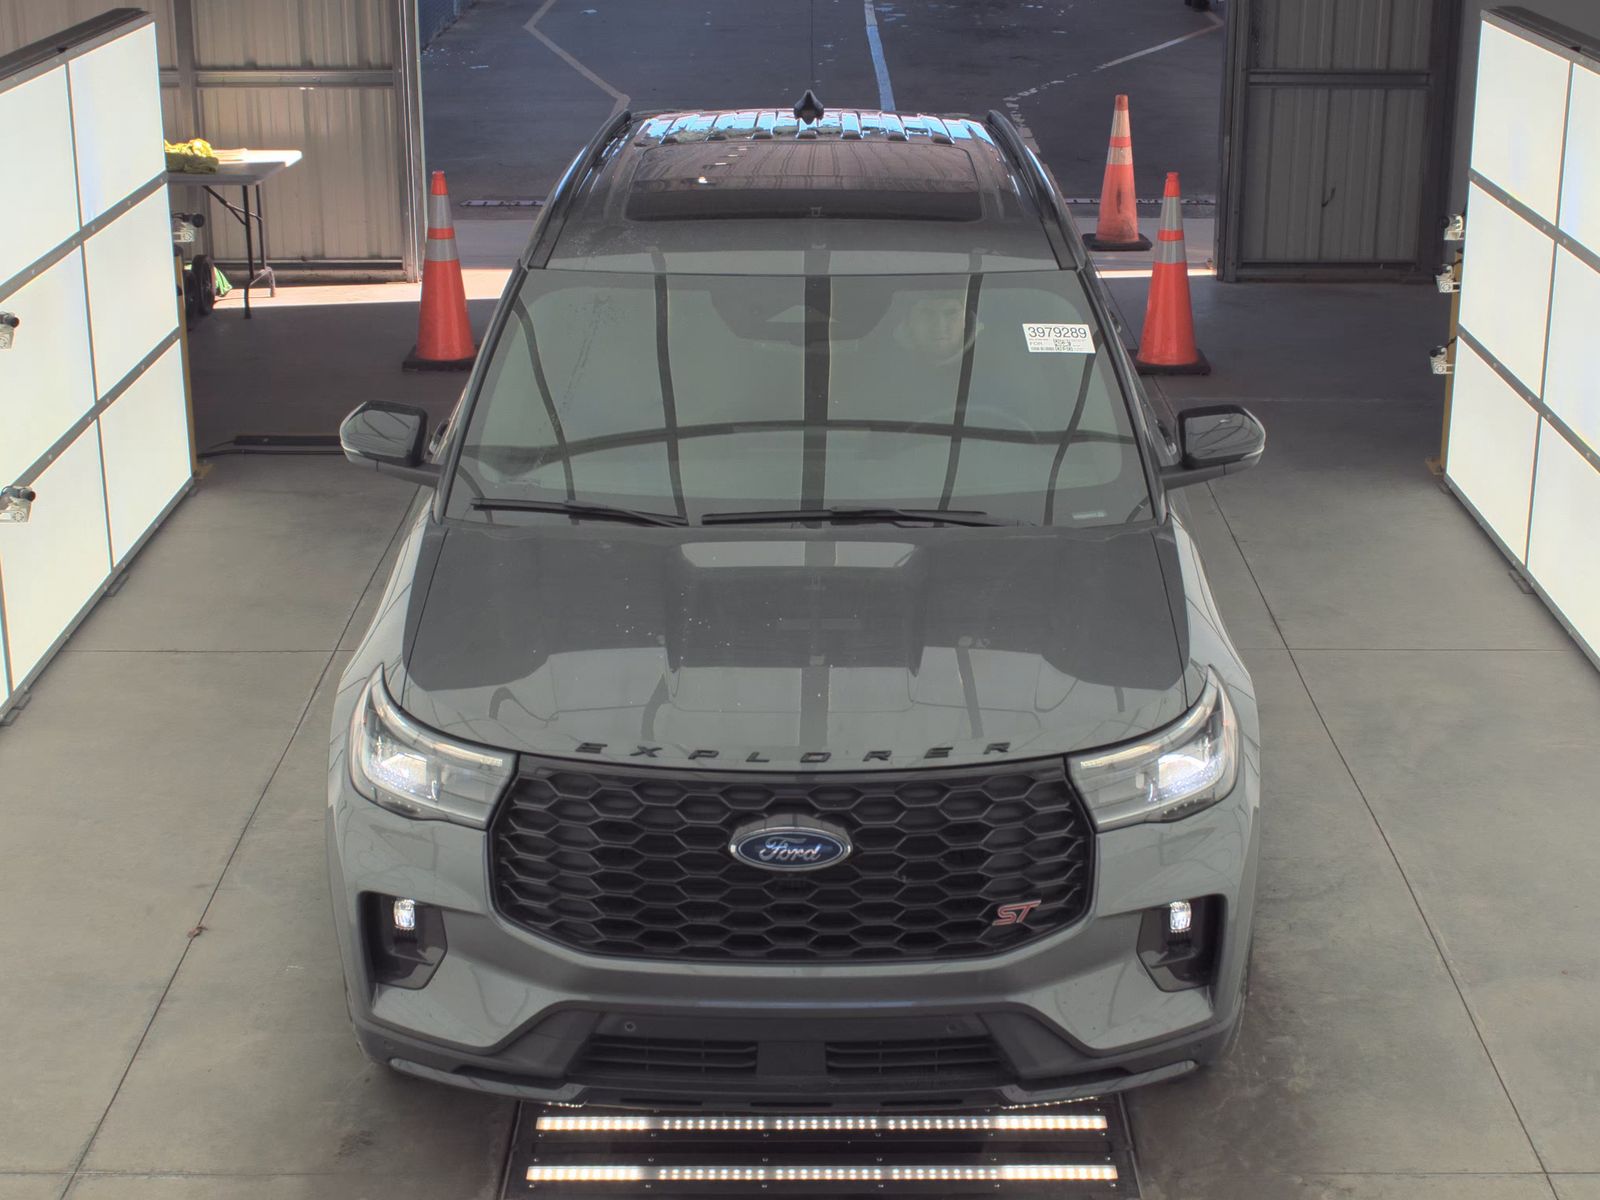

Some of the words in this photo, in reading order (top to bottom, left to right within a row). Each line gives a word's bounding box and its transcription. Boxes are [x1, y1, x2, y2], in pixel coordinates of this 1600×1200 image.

[1028, 327, 1087, 338] 3979289
[575, 742, 1010, 763] EXPLORER
[759, 837, 822, 861] Ford
[992, 900, 1041, 926] ST
